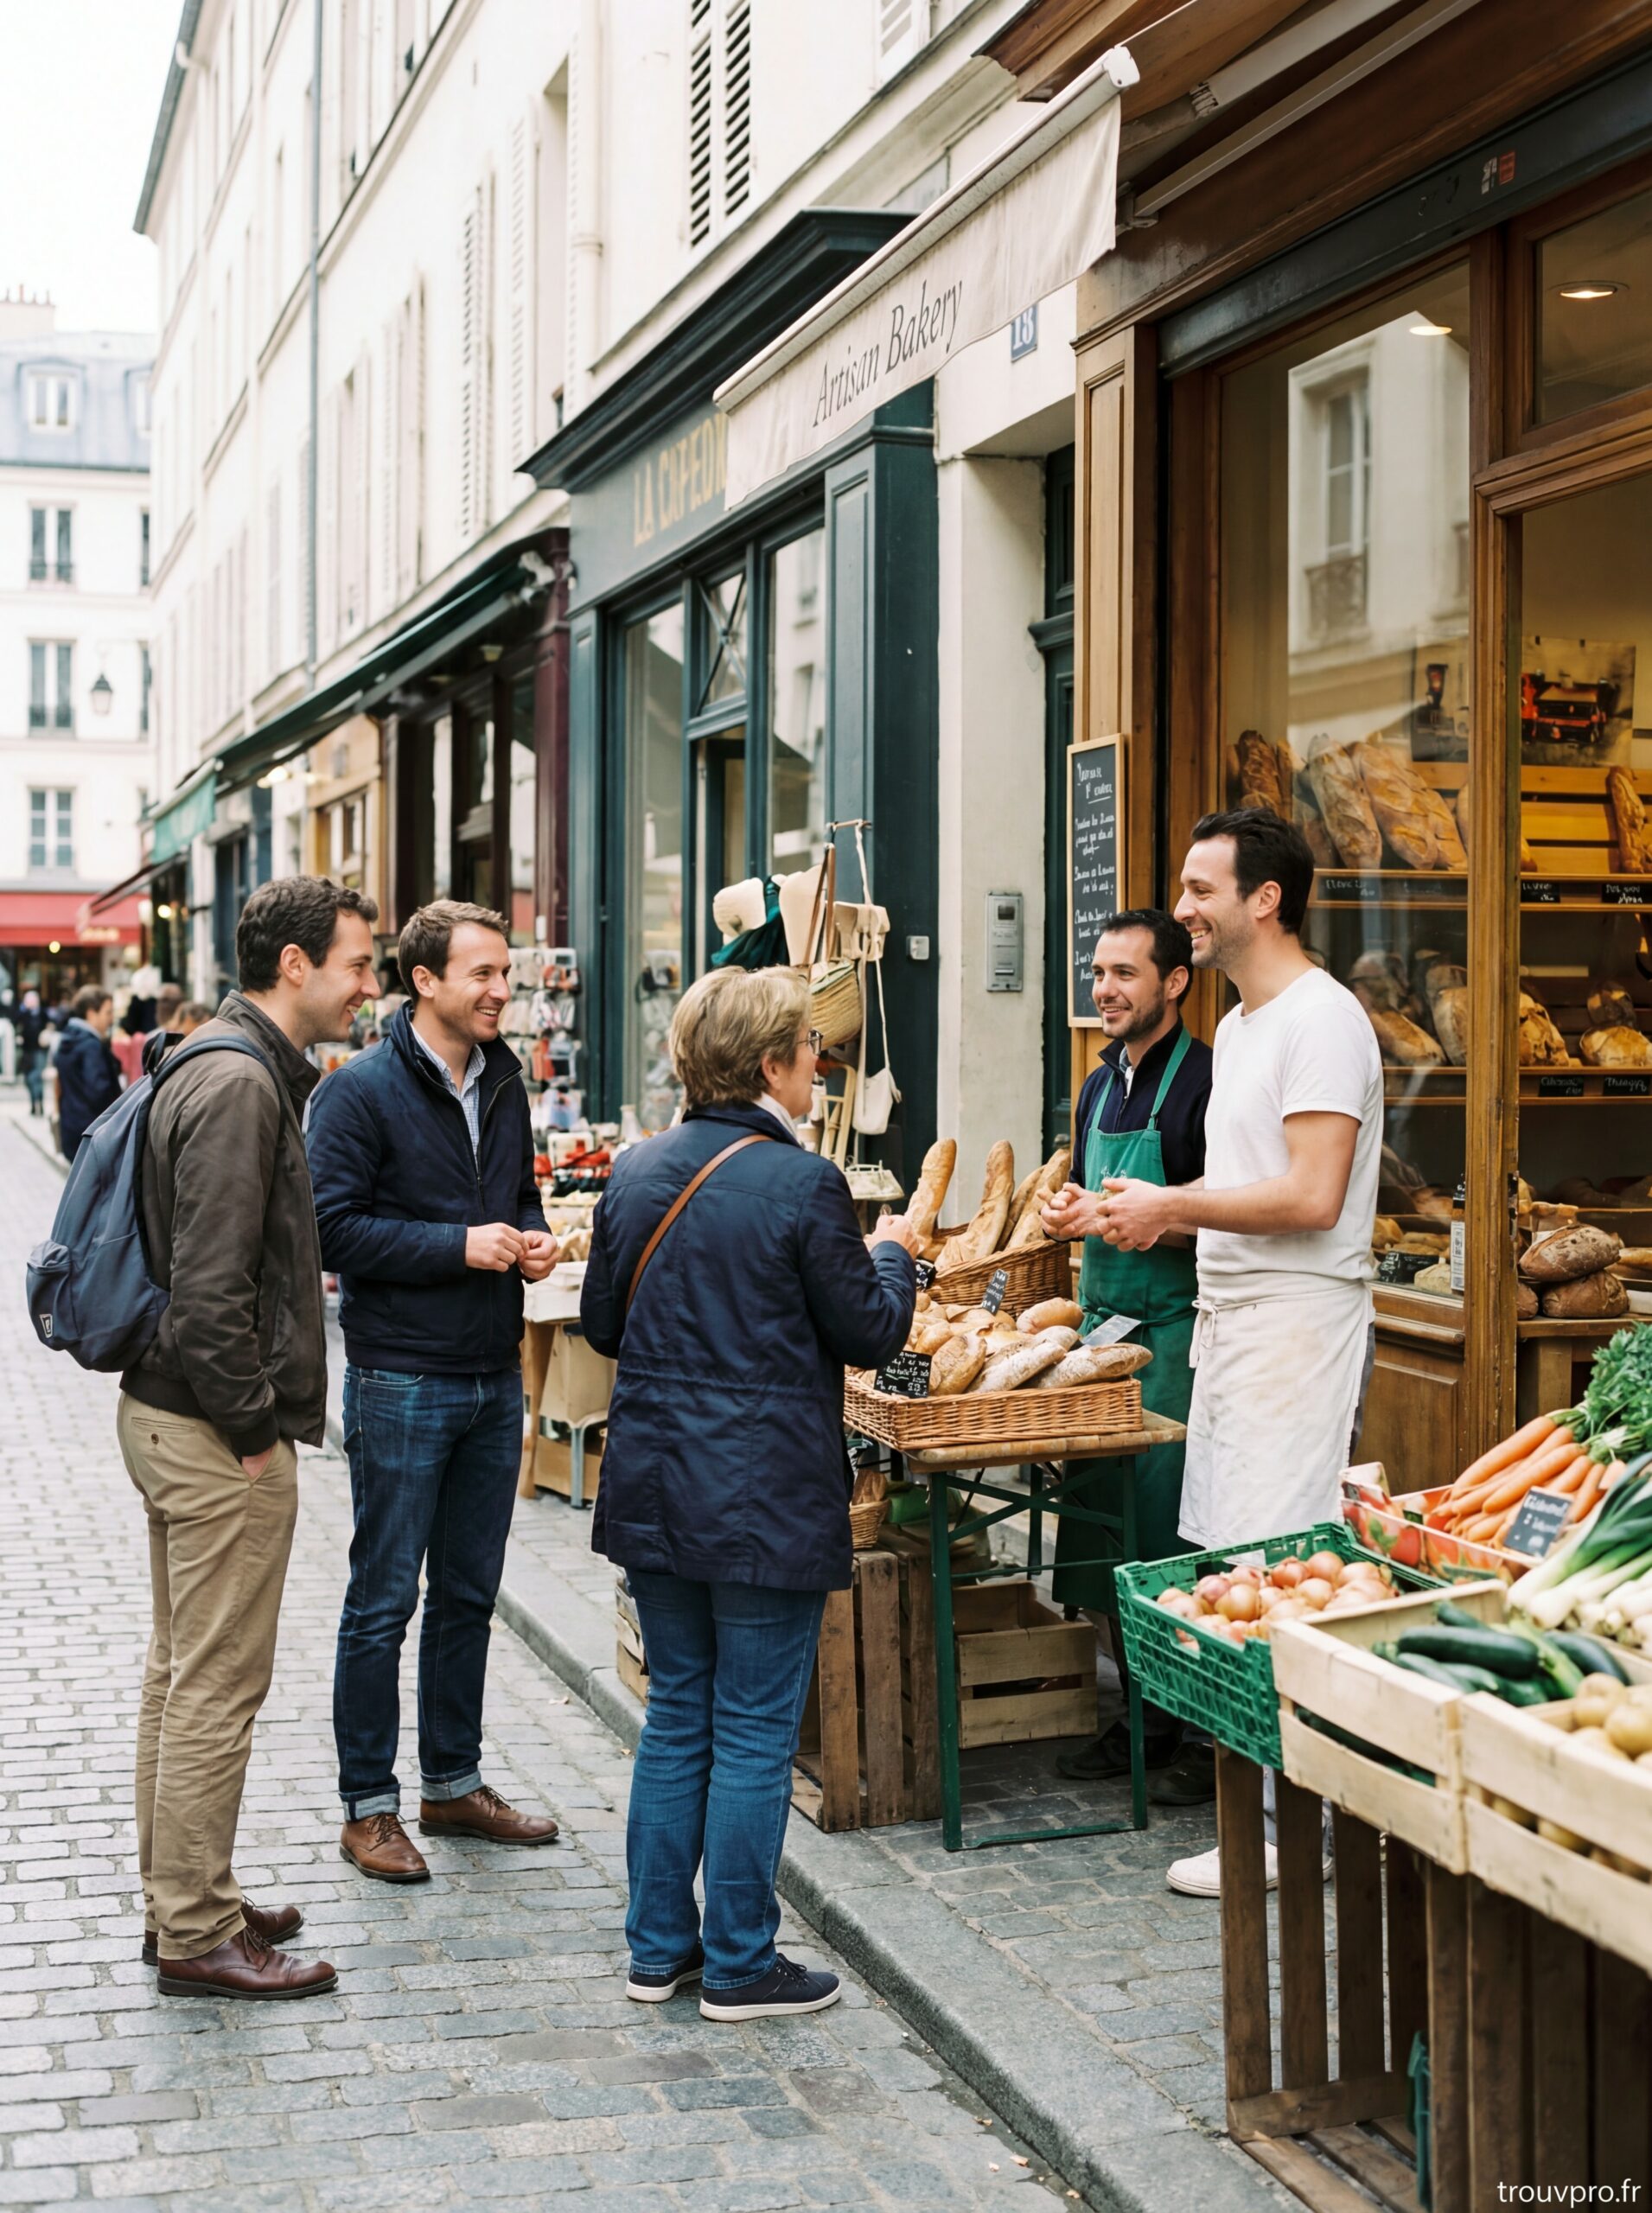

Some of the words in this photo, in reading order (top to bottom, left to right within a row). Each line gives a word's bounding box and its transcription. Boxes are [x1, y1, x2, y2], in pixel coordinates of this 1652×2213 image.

[813, 342, 879, 428] Artisan
[884, 279, 962, 374] Bakery
[1012, 306, 1035, 350] 18
